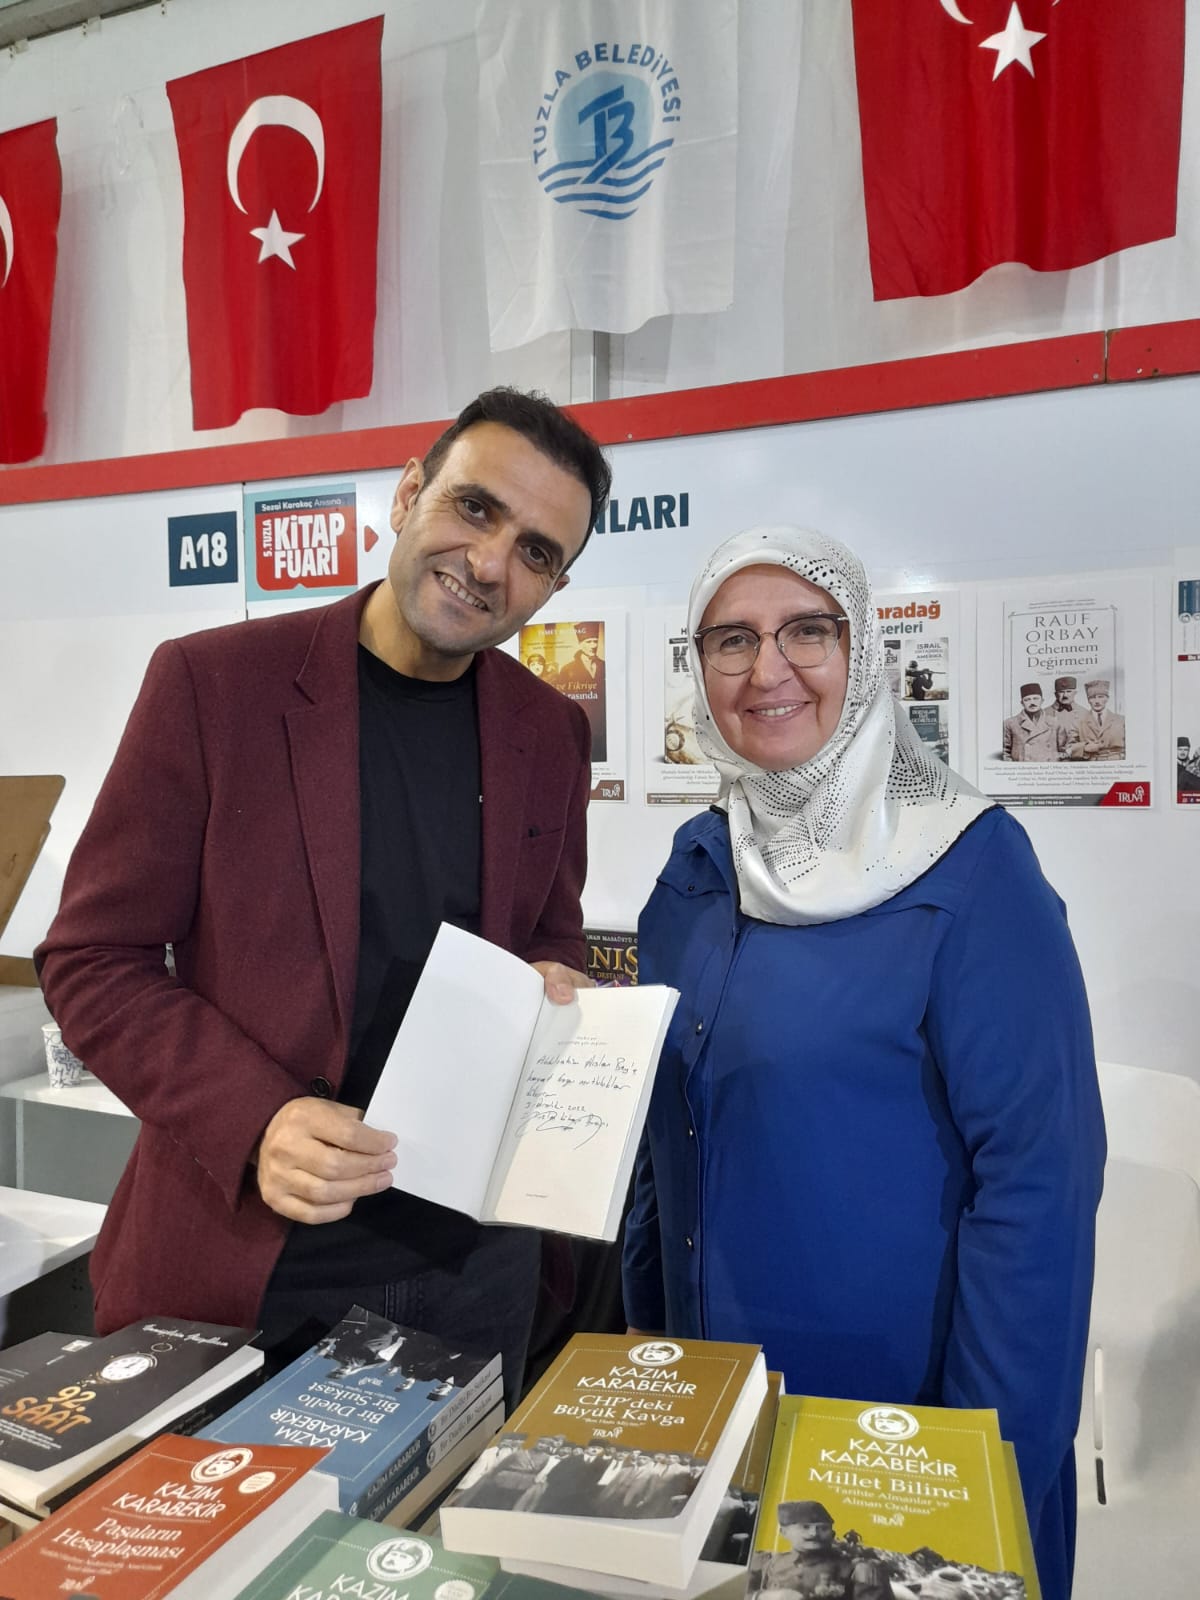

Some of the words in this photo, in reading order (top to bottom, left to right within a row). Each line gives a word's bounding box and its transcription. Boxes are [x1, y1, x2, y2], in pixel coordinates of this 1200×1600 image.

[533, 69, 572, 164] TUZLA
[575, 43, 681, 122] BELEDİYESİ
[261, 503, 281, 512] Sezai
[282, 501, 313, 511] Karakoç
[274, 512, 345, 550] KİTAP
[179, 531, 227, 570] A18
[274, 546, 339, 579] FUARI
[1035, 613, 1091, 628] RAUF
[1026, 627, 1098, 642] ORBAY
[1026, 643, 1099, 655] Cehennem
[1027, 654, 1098, 670] Değirmeni
[563, 691, 598, 700] rasında
[609, 1366, 678, 1380] KAZIM
[308, 1382, 372, 1406] Suikast
[577, 1376, 697, 1395] KARABEKİR
[47, 1386, 96, 1412] 92.
[298, 1394, 356, 1417] Düello
[372, 1399, 400, 1413] Bir
[1, 1397, 92, 1434] SAAT
[270, 1408, 372, 1444] KARABEKİR
[357, 1410, 386, 1425] Bir
[553, 1404, 617, 1419] Büyük
[622, 1409, 685, 1427] Kavga
[274, 1425, 338, 1447] KAZIM
[850, 1438, 928, 1459] KAZIM
[820, 1449, 958, 1478] KARABEKİR
[154, 1481, 224, 1500] KAZIM
[808, 1468, 881, 1490] Millet
[890, 1478, 970, 1501] Bilinci
[112, 1492, 226, 1518] KARABEKİR
[93, 1517, 182, 1541] Paşaların
[52, 1527, 186, 1560] Hesaplaşması
